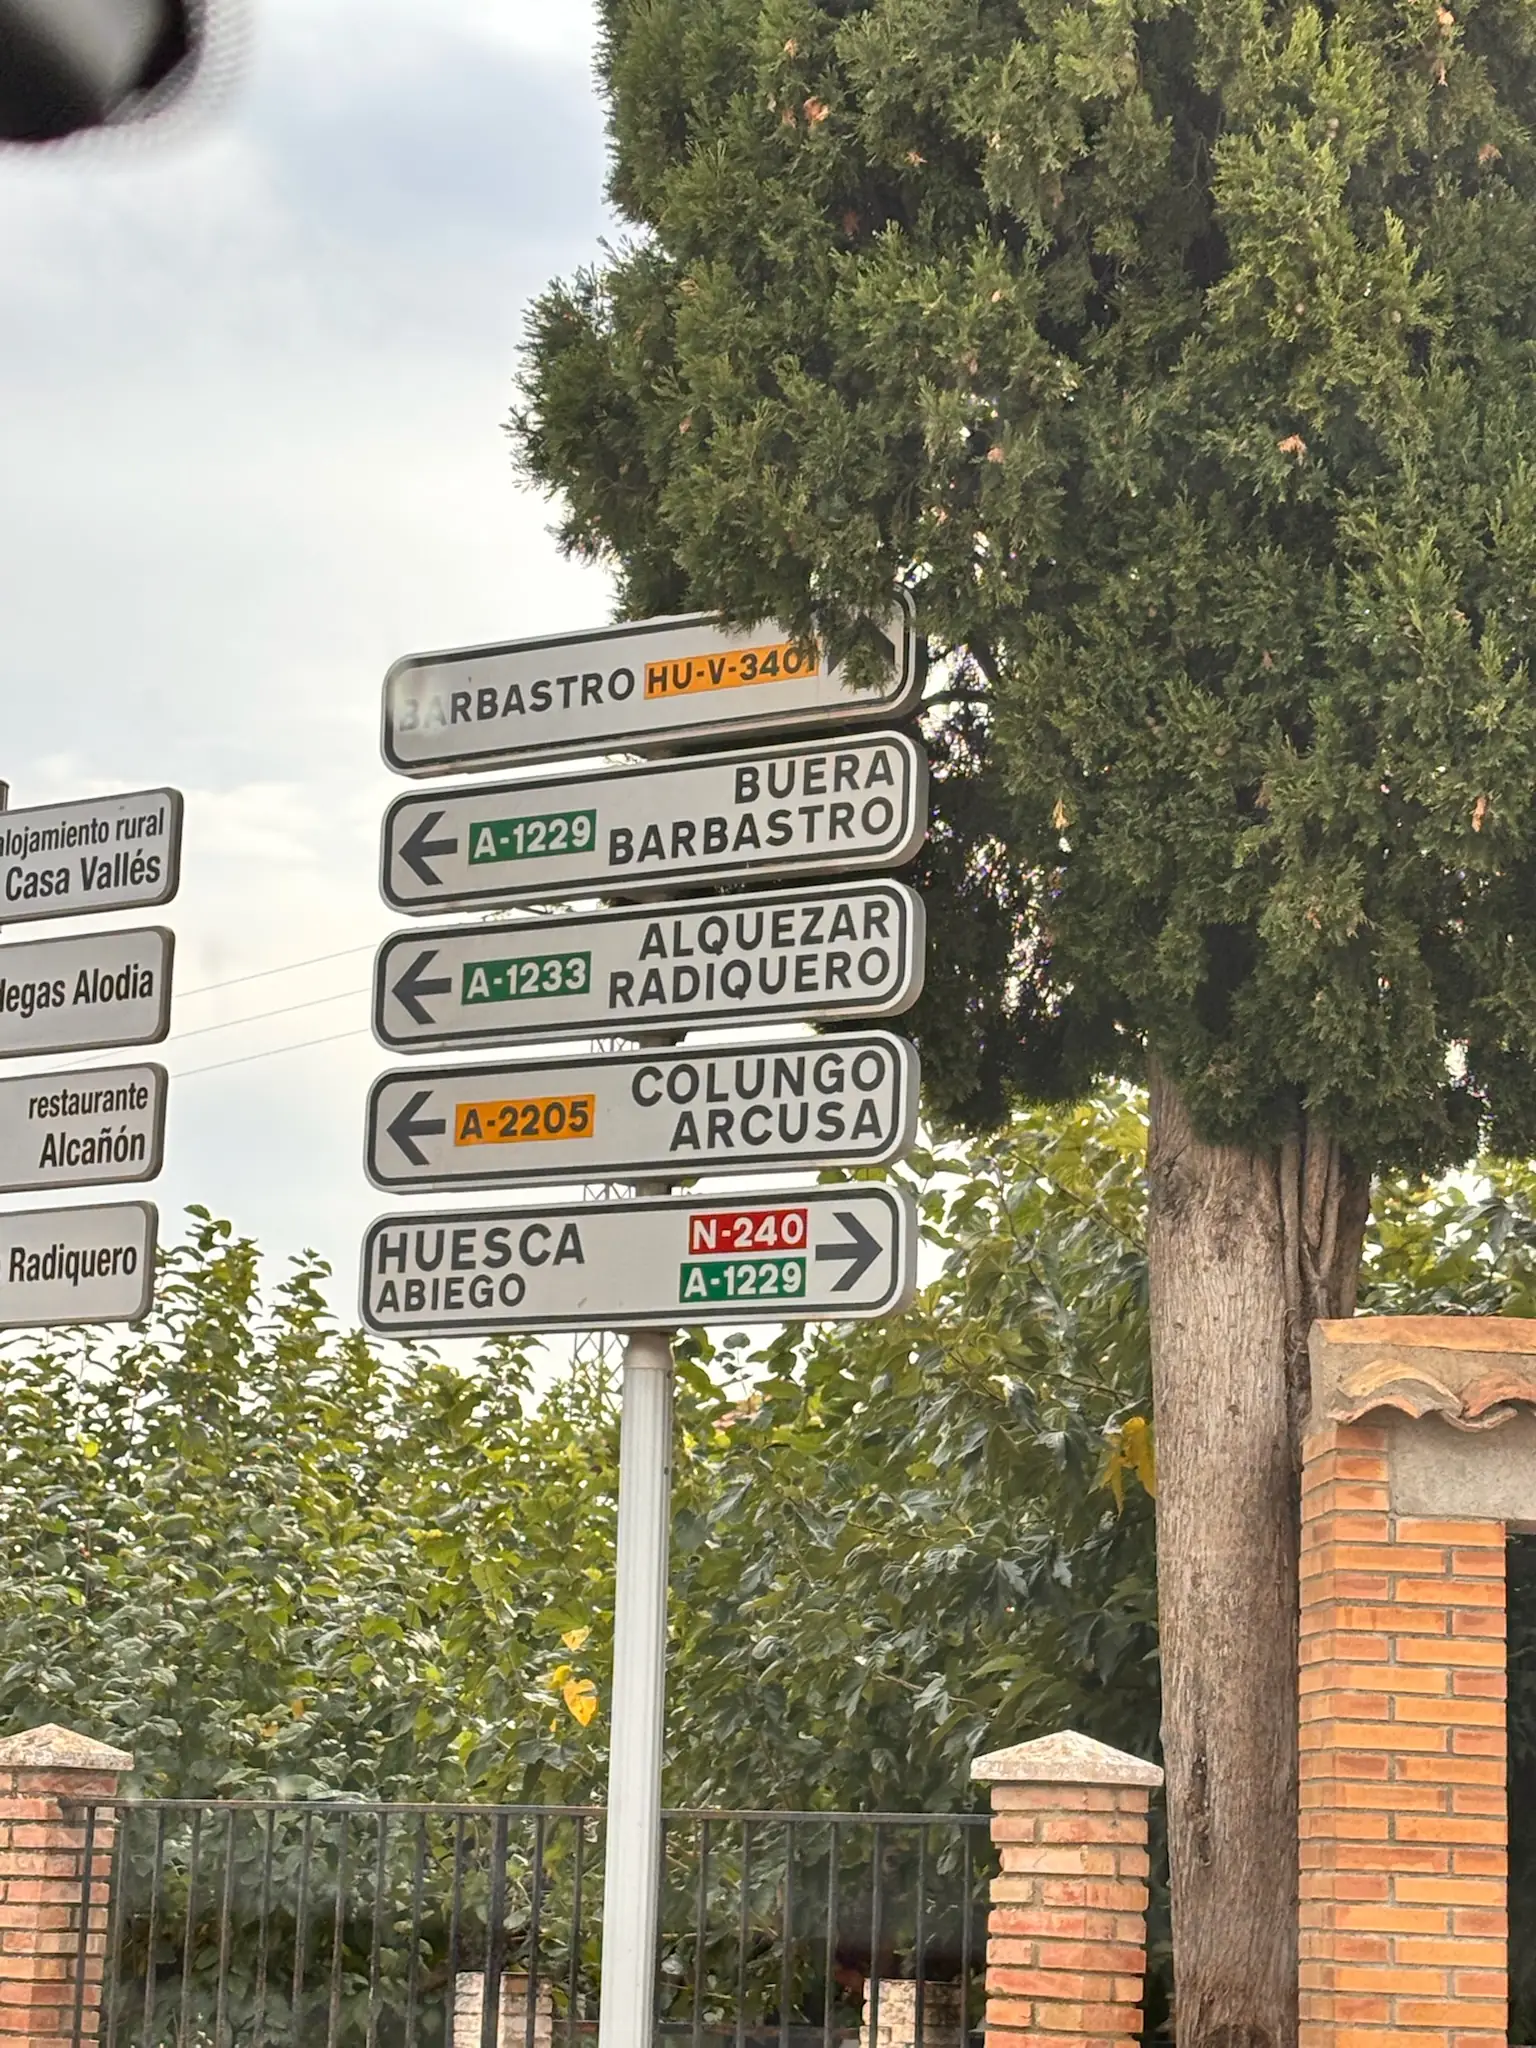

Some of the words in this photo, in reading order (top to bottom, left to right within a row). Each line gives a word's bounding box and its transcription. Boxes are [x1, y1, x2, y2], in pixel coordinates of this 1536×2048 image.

[399, 667, 635, 732] BARBASTRO
[735, 750, 895, 804] BUERA
[116, 807, 164, 841] rural
[473, 818, 591, 861] A-1229
[609, 796, 893, 865] BARBASTRO
[6, 866, 70, 901] Casa
[80, 848, 161, 891] Vallés
[639, 901, 890, 960] ALQUEZAR
[72, 963, 153, 1005] Alodia
[466, 957, 586, 999] A-1233
[609, 947, 890, 1009] RADIQUERO
[29, 1082, 148, 1119] restaurante
[631, 1050, 885, 1107] COLUNGO
[459, 1100, 589, 1139] A-2205
[669, 1099, 883, 1151] ARCUSA
[39, 1125, 145, 1169] Alcañón
[377, 1223, 585, 1274] HUESCA
[692, 1213, 803, 1250] N-240
[9, 1243, 137, 1287] Radiquero
[684, 1261, 802, 1297] A-1229
[375, 1273, 526, 1313] ABIEGO
